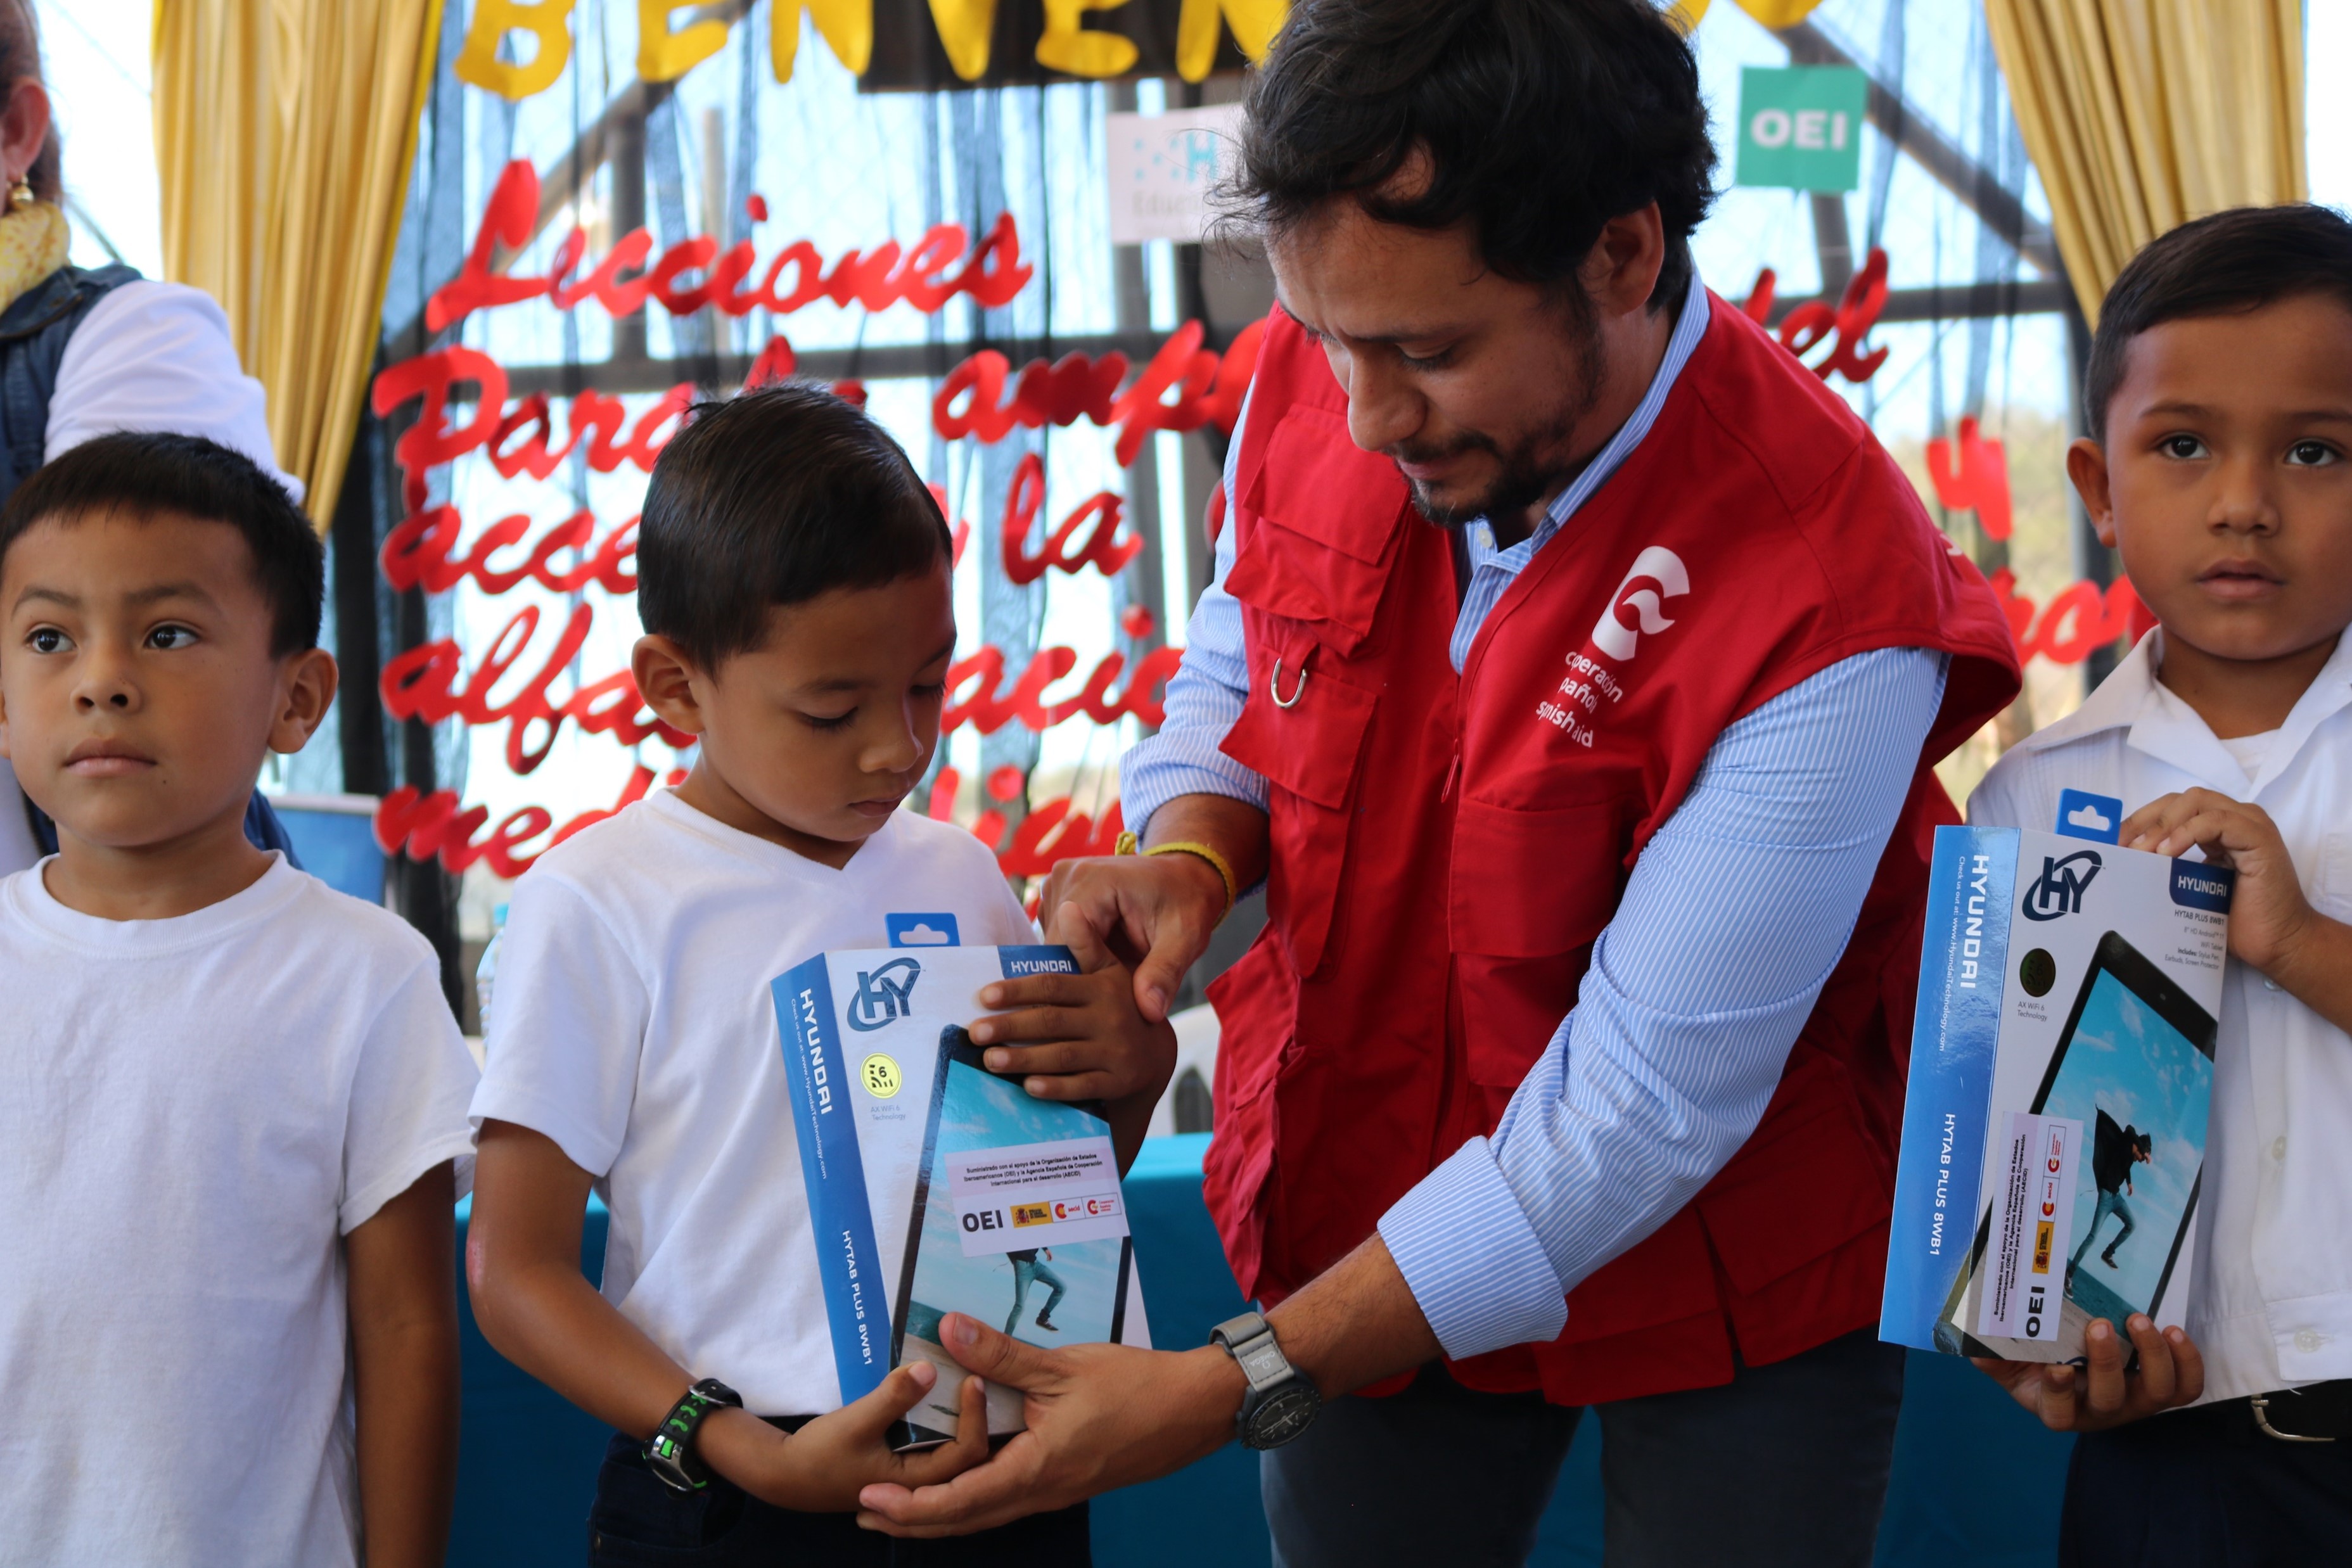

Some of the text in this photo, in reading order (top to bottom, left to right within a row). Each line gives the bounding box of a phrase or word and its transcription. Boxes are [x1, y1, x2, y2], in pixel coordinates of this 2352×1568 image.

[1750, 108, 1849, 151] OEI
[1001, 452, 1144, 585] la
[1956, 881, 1961, 889] us
[2177, 875, 2228, 898] HYUNDAI
[1960, 854, 1990, 989] HYUNDAI
[2174, 910, 2225, 926] HYTAB PLUS 8WB1
[1010, 959, 1072, 973] HYUNDAI
[2177, 947, 2197, 957] Includes:
[2185, 957, 2199, 966] Screen
[1939, 917, 1958, 1052] www.HyundaiTechnology.com
[2017, 1009, 2048, 1023] Technology
[2028, 1002, 2040, 1010] WiFi
[800, 988, 833, 1115] HYUNDAI
[795, 1021, 799, 1030] us
[802, 1054, 827, 1180] www.HyundaiTechnology.com
[872, 1112, 906, 1121] Technology
[1930, 1114, 1955, 1254] HYTAB PLUS 8WB1
[2011, 1165, 2017, 1173] de
[2005, 1175, 2014, 1215] Organización
[962, 1209, 1004, 1232] OEI
[1999, 1270, 2009, 1322] Iberoamericanos
[2017, 1134, 2025, 1173] Cooperación
[2004, 1223, 2009, 1232] de
[2009, 1249, 2017, 1289] Internacional
[843, 1230, 871, 1364] HYTAB PLUS 8WB1
[1993, 1274, 2002, 1315] Suministrado
[2026, 1286, 2045, 1338] OEI
